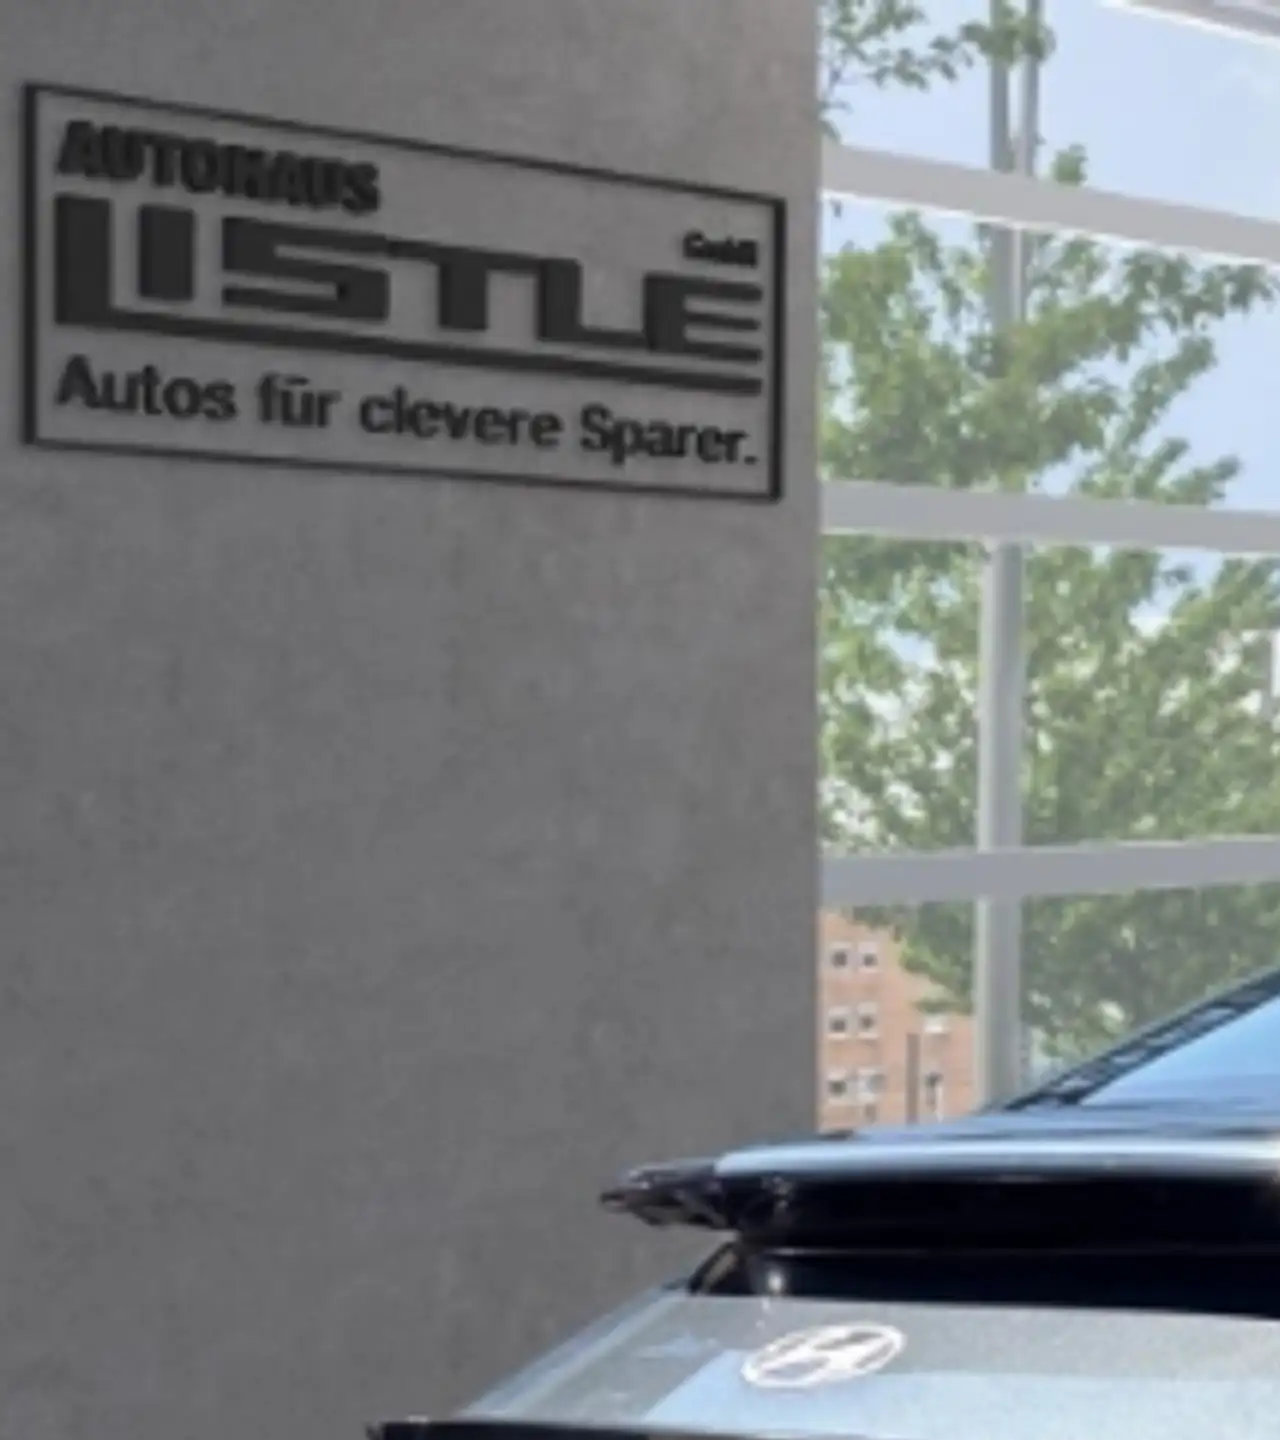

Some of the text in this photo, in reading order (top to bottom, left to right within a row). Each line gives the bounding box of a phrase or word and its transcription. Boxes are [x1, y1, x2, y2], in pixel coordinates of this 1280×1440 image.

[58, 121, 380, 214] AUTOHAUS
[57, 356, 758, 465] Autos für clevere Sparer.
